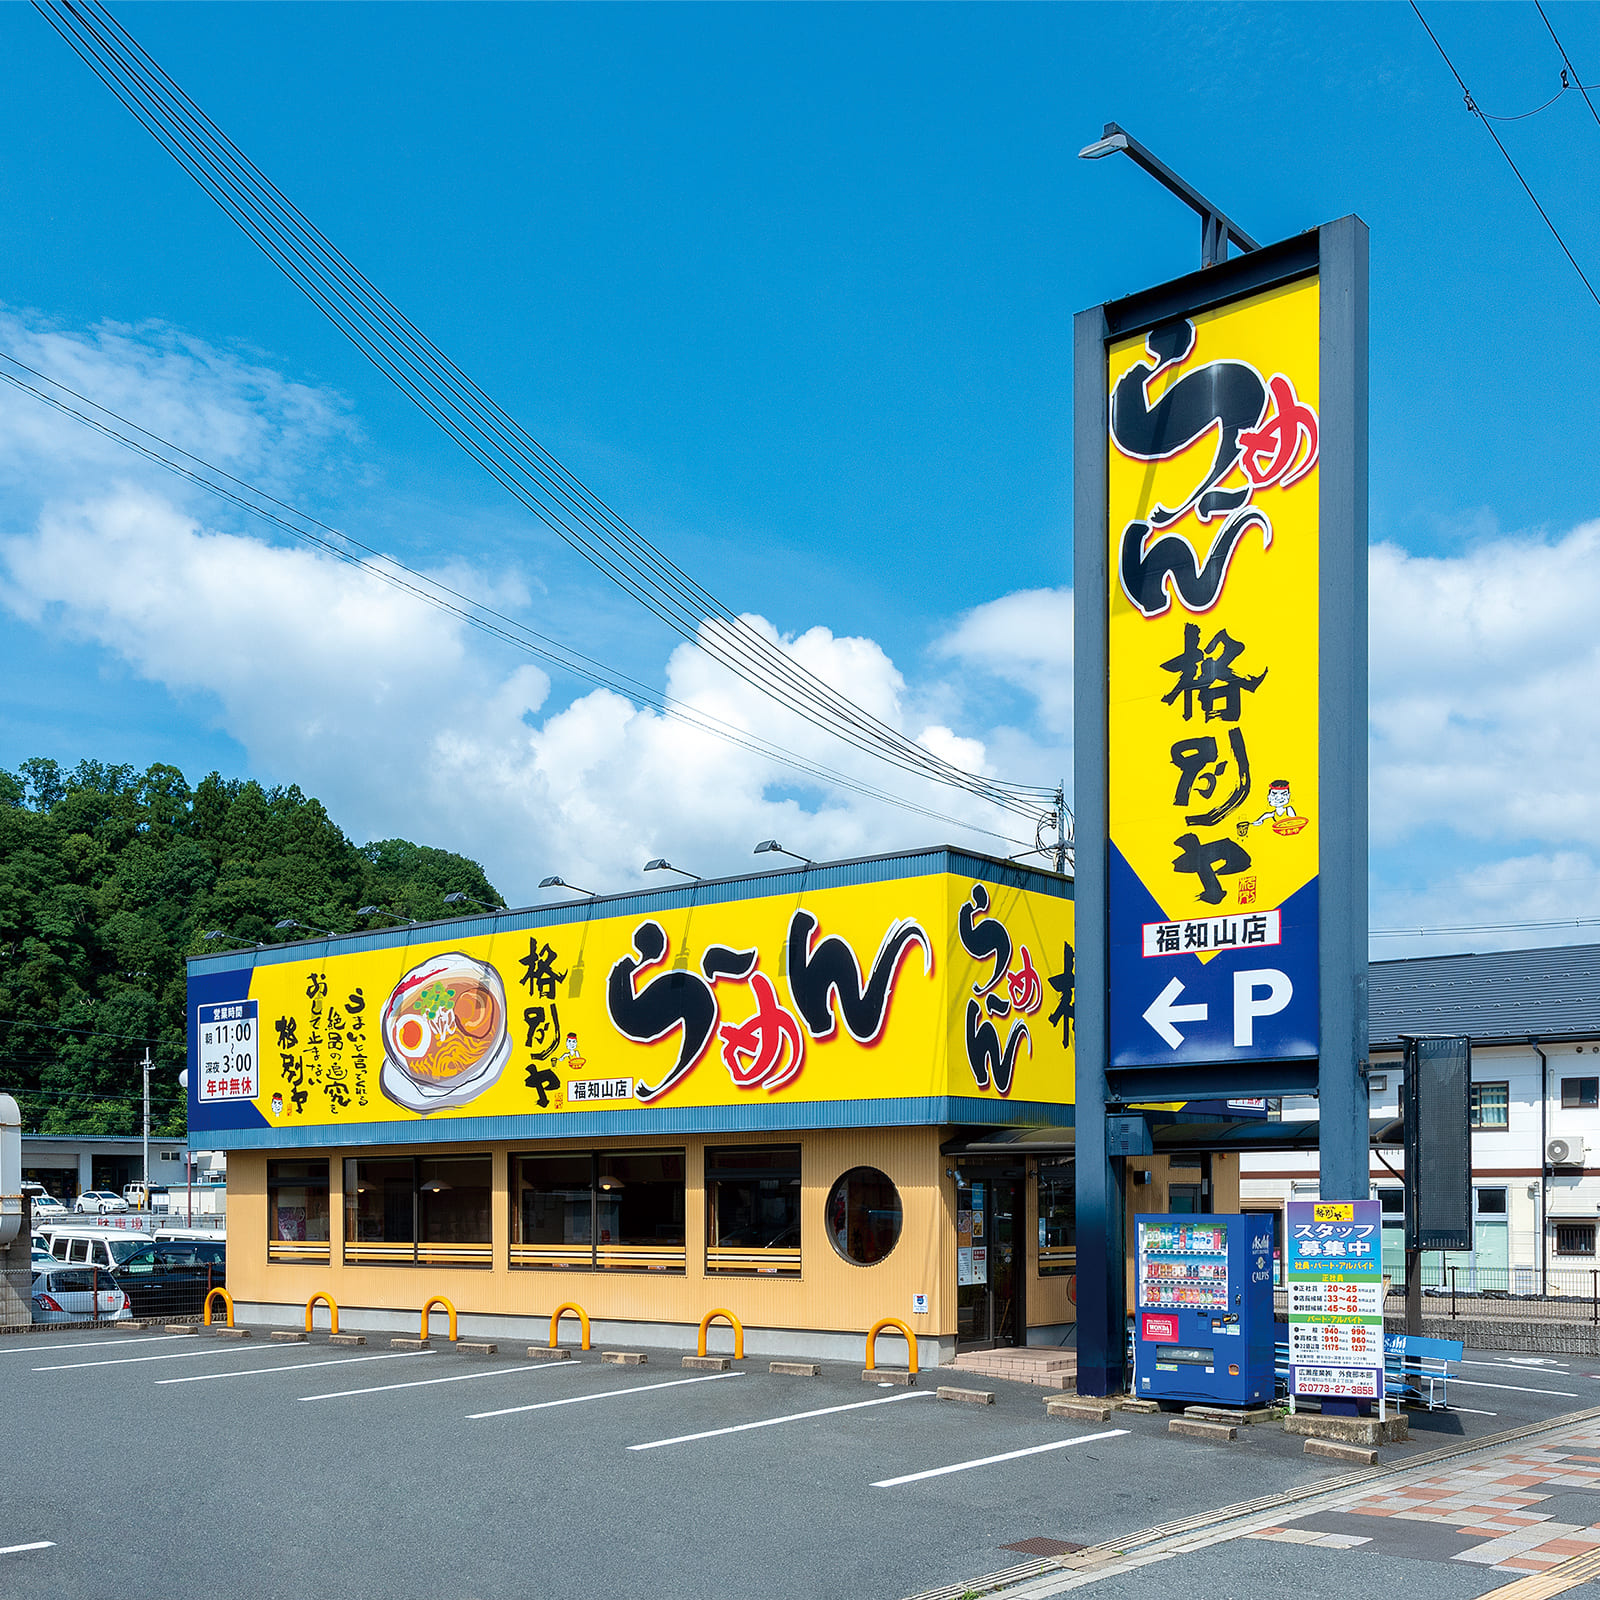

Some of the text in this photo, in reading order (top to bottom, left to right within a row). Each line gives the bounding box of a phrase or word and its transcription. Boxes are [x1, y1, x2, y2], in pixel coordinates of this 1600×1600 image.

[1156, 915, 1267, 953] 福知山店
[213, 1006, 243, 1020] 営業時間
[1234, 968, 1293, 1047] P
[215, 1023, 252, 1043] 11:00
[205, 1053, 252, 1074] 深夜 3:00
[206, 1076, 252, 1097] 年中無休
[574, 1080, 628, 1099] 福知山店
[1294, 1223, 1376, 1239] スタッフ
[1298, 1240, 1371, 1257] 募集中
[1321, 1273, 1344, 1282] 正社員
